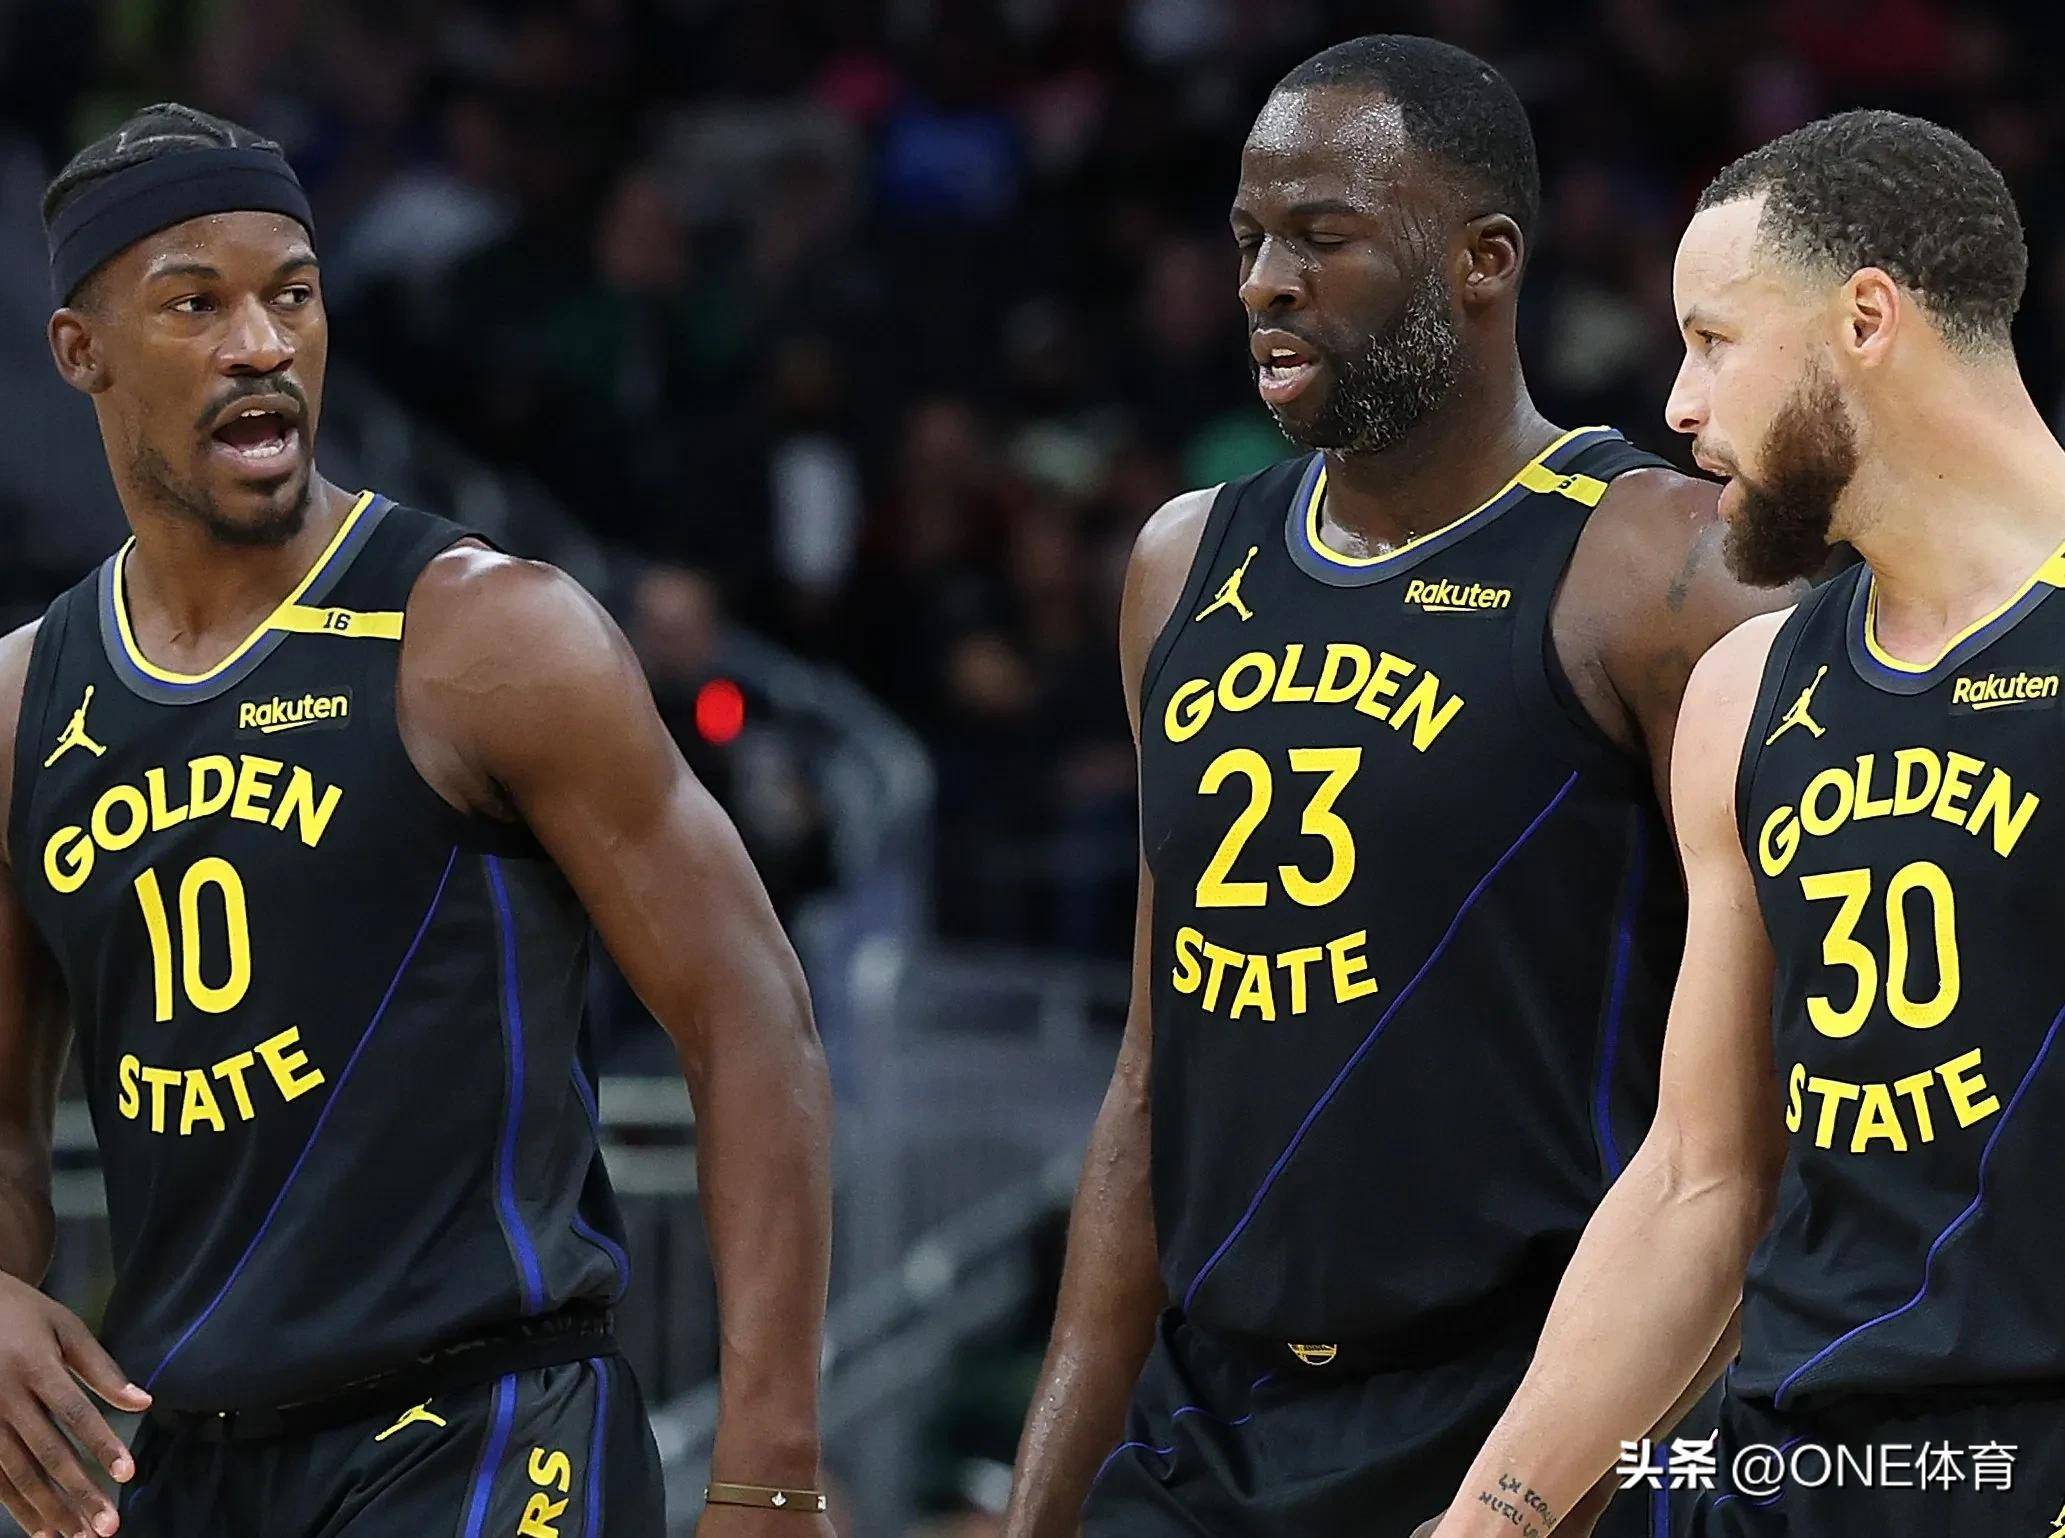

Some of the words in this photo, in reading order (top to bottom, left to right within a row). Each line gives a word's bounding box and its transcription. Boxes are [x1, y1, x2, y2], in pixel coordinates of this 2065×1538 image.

[322, 611, 351, 631] 16
[1404, 579, 1511, 608] Rakuten
[238, 693, 348, 729] Rakuten
[1164, 645, 1462, 751] GOLDEN
[1952, 672, 2060, 704] Rakuten
[43, 755, 343, 894] GOLDEN
[1195, 748, 1362, 909] 23
[1759, 746, 2039, 877] GOLDEN
[134, 856, 252, 1022] 10
[1172, 927, 1379, 1022] STATE
[1799, 861, 1960, 1038] 30
[118, 1026, 325, 1135] STATE
[1785, 1048, 2000, 1153] STATE
